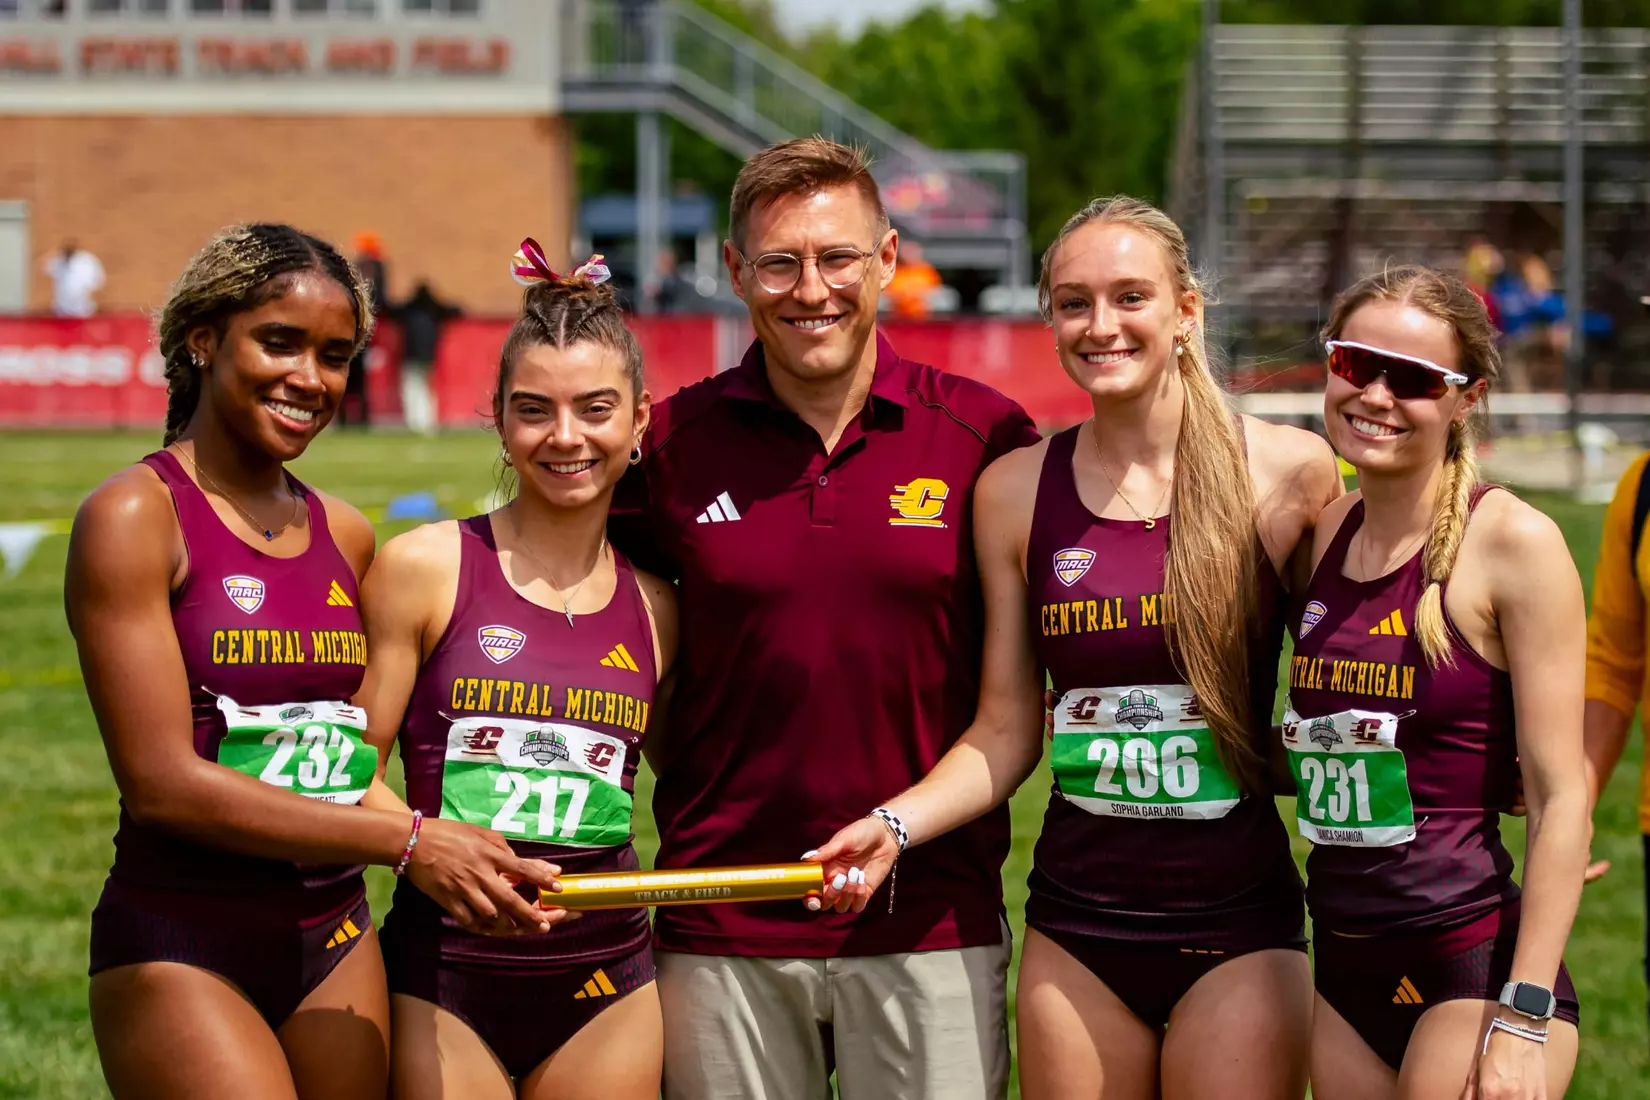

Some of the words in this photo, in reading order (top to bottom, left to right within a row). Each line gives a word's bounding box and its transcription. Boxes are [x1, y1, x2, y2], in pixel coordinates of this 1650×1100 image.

[1055, 560, 1091, 570] MAC
[229, 587, 263, 598] MAC
[1041, 597, 1128, 637] CENTRAL
[212, 630, 305, 664] CENTRAL
[481, 636, 522, 650] MAC
[1331, 660, 1415, 699] MICHIGAN
[451, 677, 553, 717] CENTRAL
[565, 687, 649, 734] MICHIGAN
[259, 726, 355, 789] 232
[1087, 735, 1200, 799] 206
[491, 771, 590, 838] 217
[1300, 756, 1373, 823] 231
[1111, 803, 1141, 817] SOPHIA
[1142, 804, 1184, 818] GARLAND
[635, 889, 678, 901] TRACK
[683, 888, 692, 899] &
[695, 886, 732, 898] FIELD
